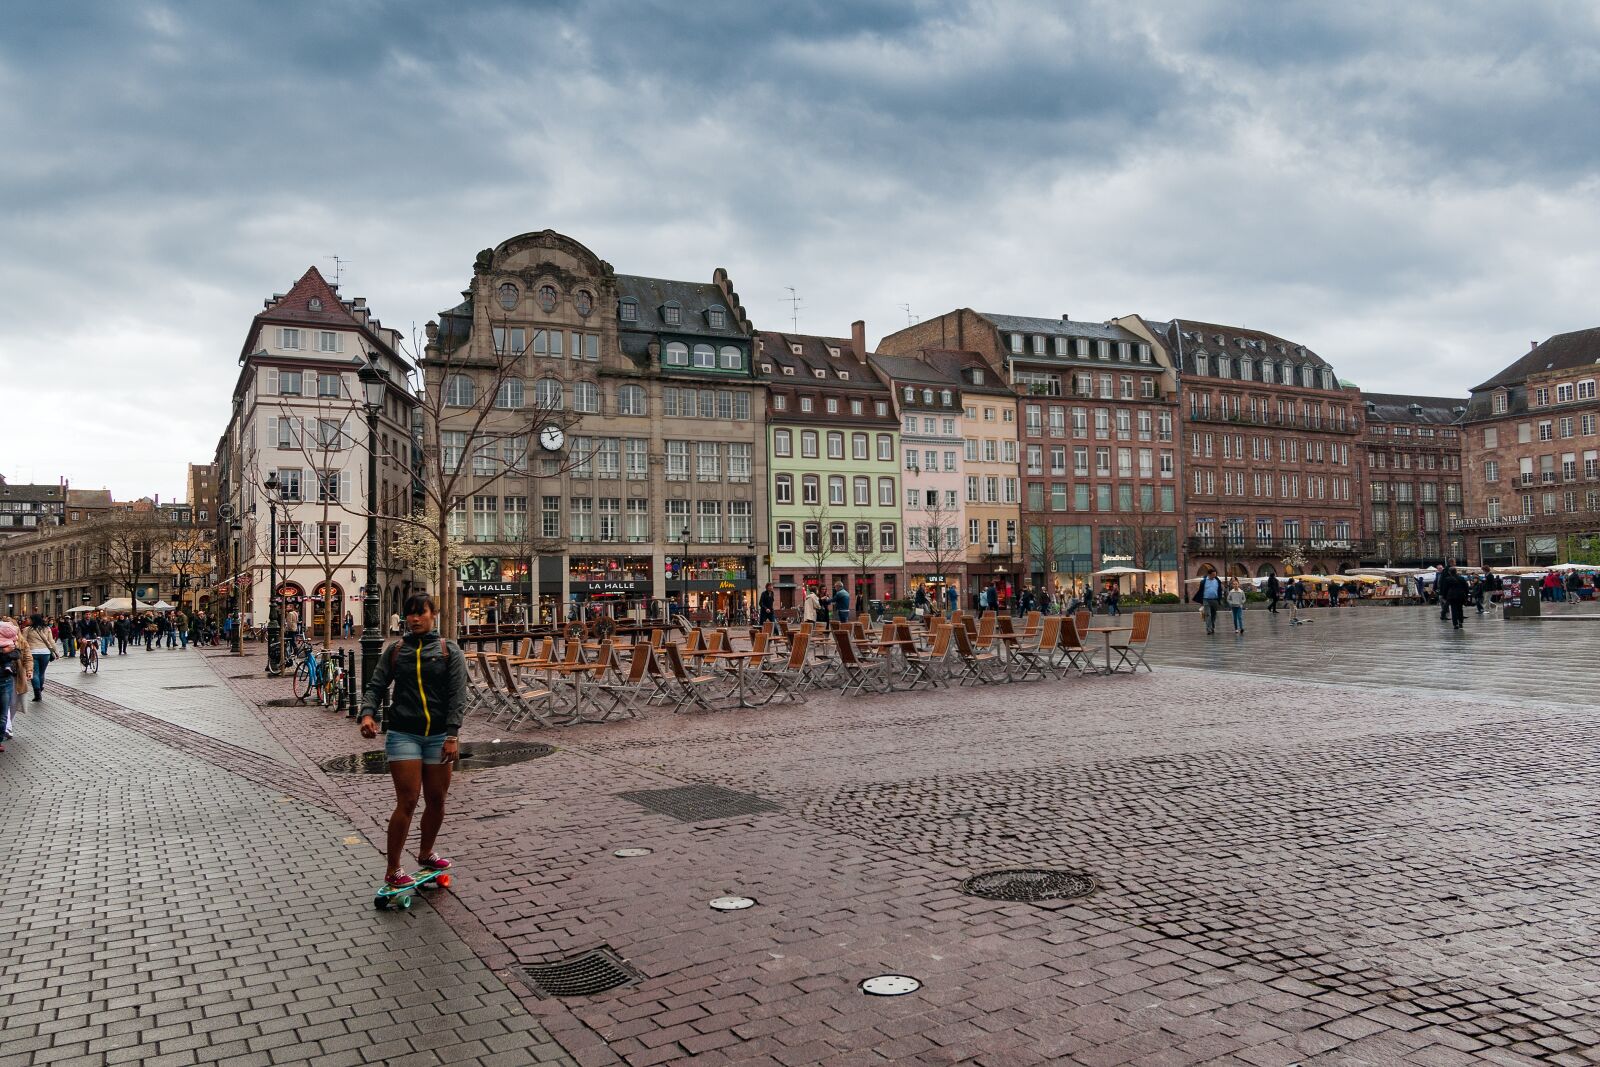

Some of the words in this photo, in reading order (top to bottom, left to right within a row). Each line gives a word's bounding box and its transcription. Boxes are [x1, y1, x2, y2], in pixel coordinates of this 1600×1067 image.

[1455, 517, 1499, 525] DETECTIVE
[1310, 540, 1351, 549] LANCEL
[462, 584, 475, 592] LA
[604, 582, 635, 590] HALLE
